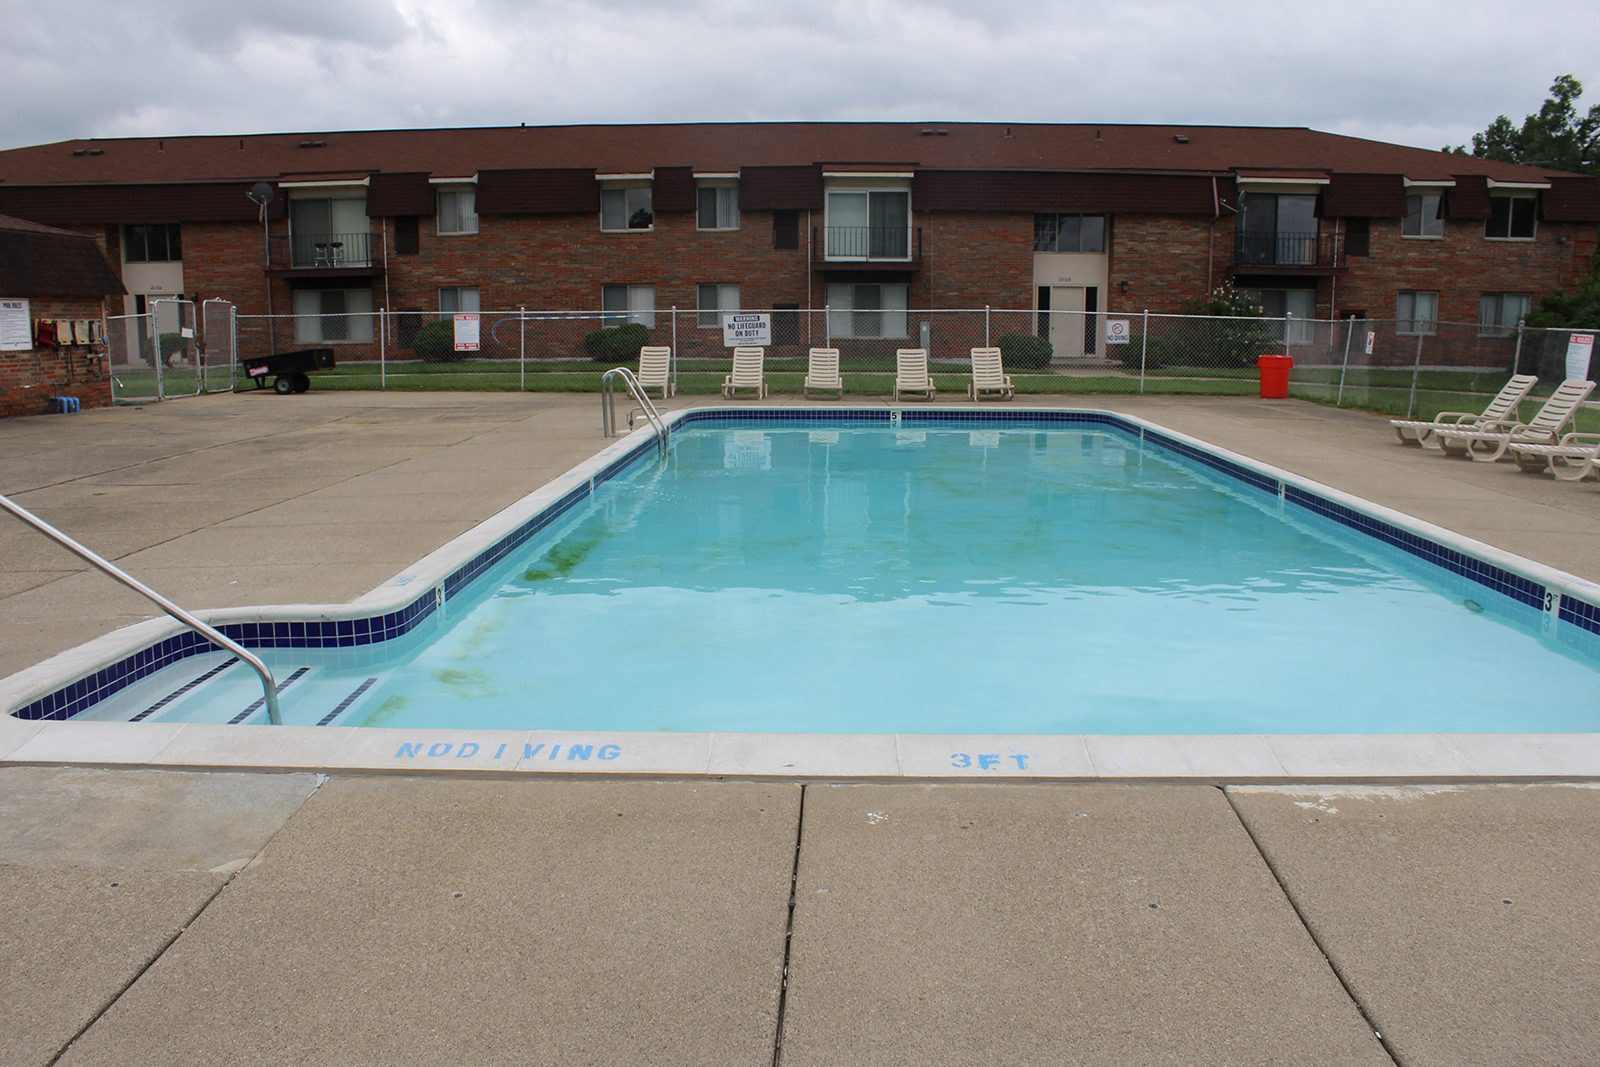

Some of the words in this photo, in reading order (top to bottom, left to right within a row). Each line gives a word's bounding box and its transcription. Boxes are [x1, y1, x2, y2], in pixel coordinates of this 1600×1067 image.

[737, 322, 766, 330] LIFEGUARD
[891, 412, 897, 420] 5
[437, 588, 442, 607] 3
[1545, 592, 1552, 612] 3
